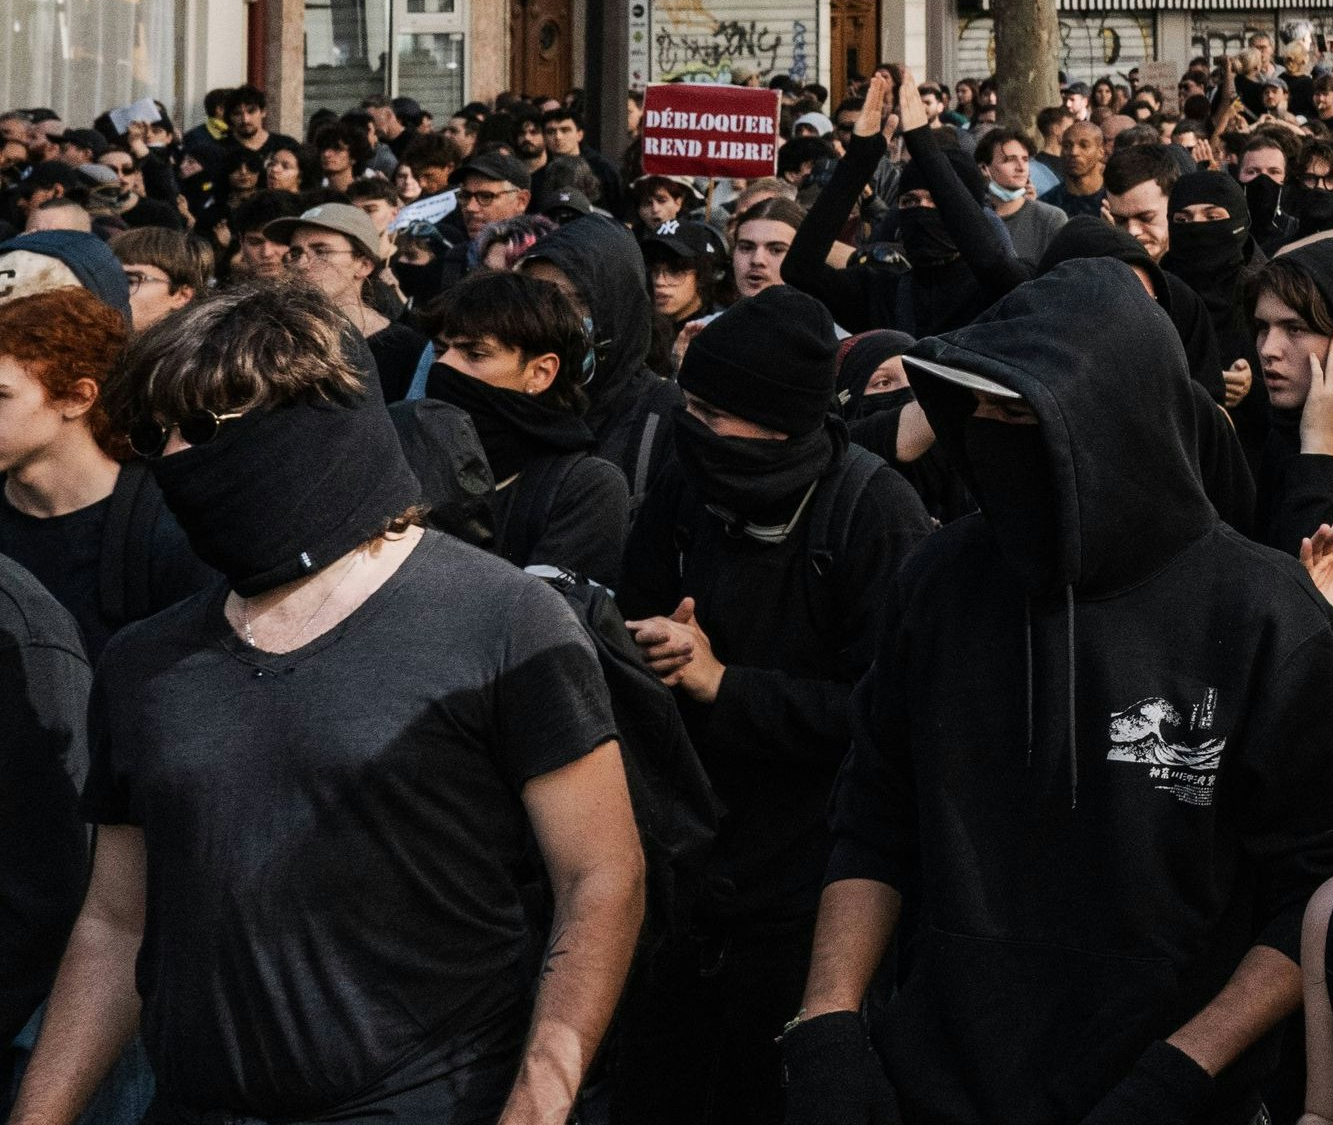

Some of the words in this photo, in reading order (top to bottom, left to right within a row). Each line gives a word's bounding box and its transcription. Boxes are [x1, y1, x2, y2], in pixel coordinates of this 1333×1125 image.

[646, 107, 774, 134] DÉBLOQUER
[644, 137, 702, 157] REND
[707, 140, 774, 161] LIBRE
